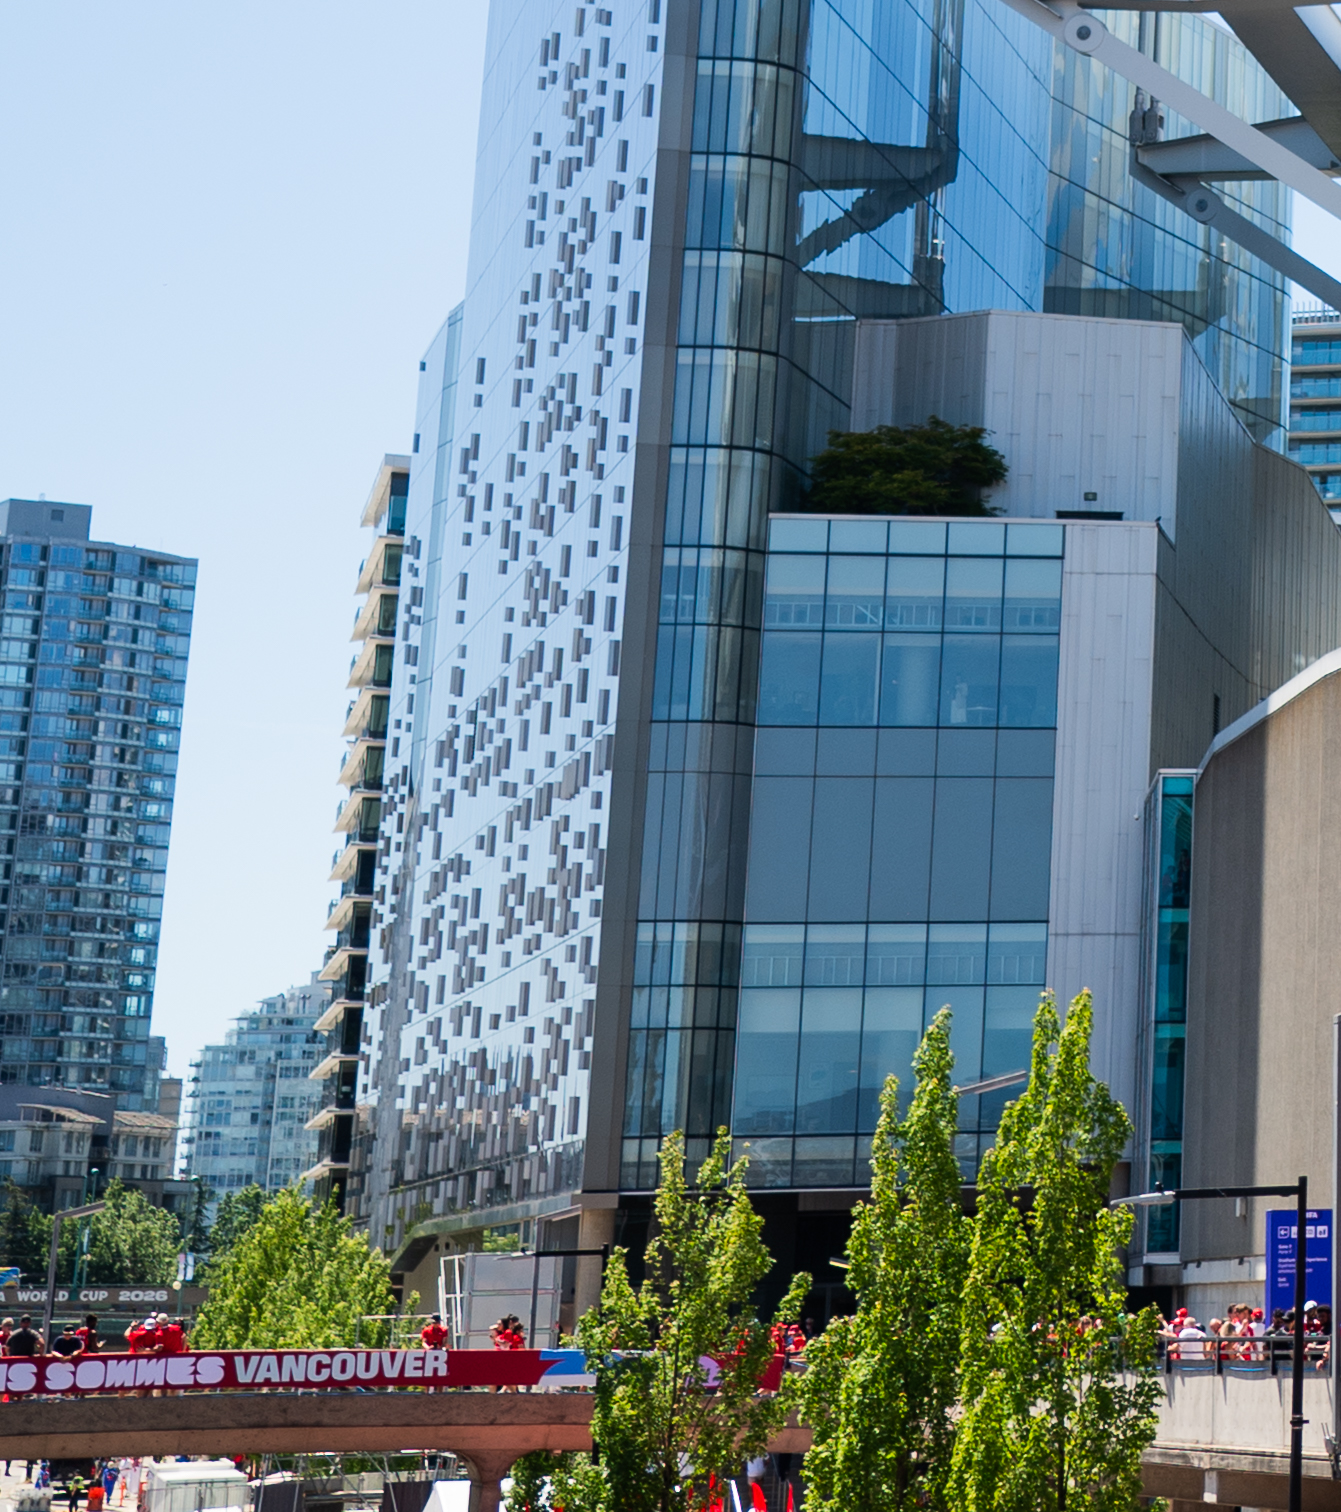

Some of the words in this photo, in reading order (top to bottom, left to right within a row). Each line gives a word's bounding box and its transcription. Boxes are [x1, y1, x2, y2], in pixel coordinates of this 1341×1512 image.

[79, 1289, 108, 1302] CUP
[118, 1289, 168, 1302] 2026
[45, 1356, 225, 1390] SOMMES
[234, 1349, 447, 1384] VANCOUVER
